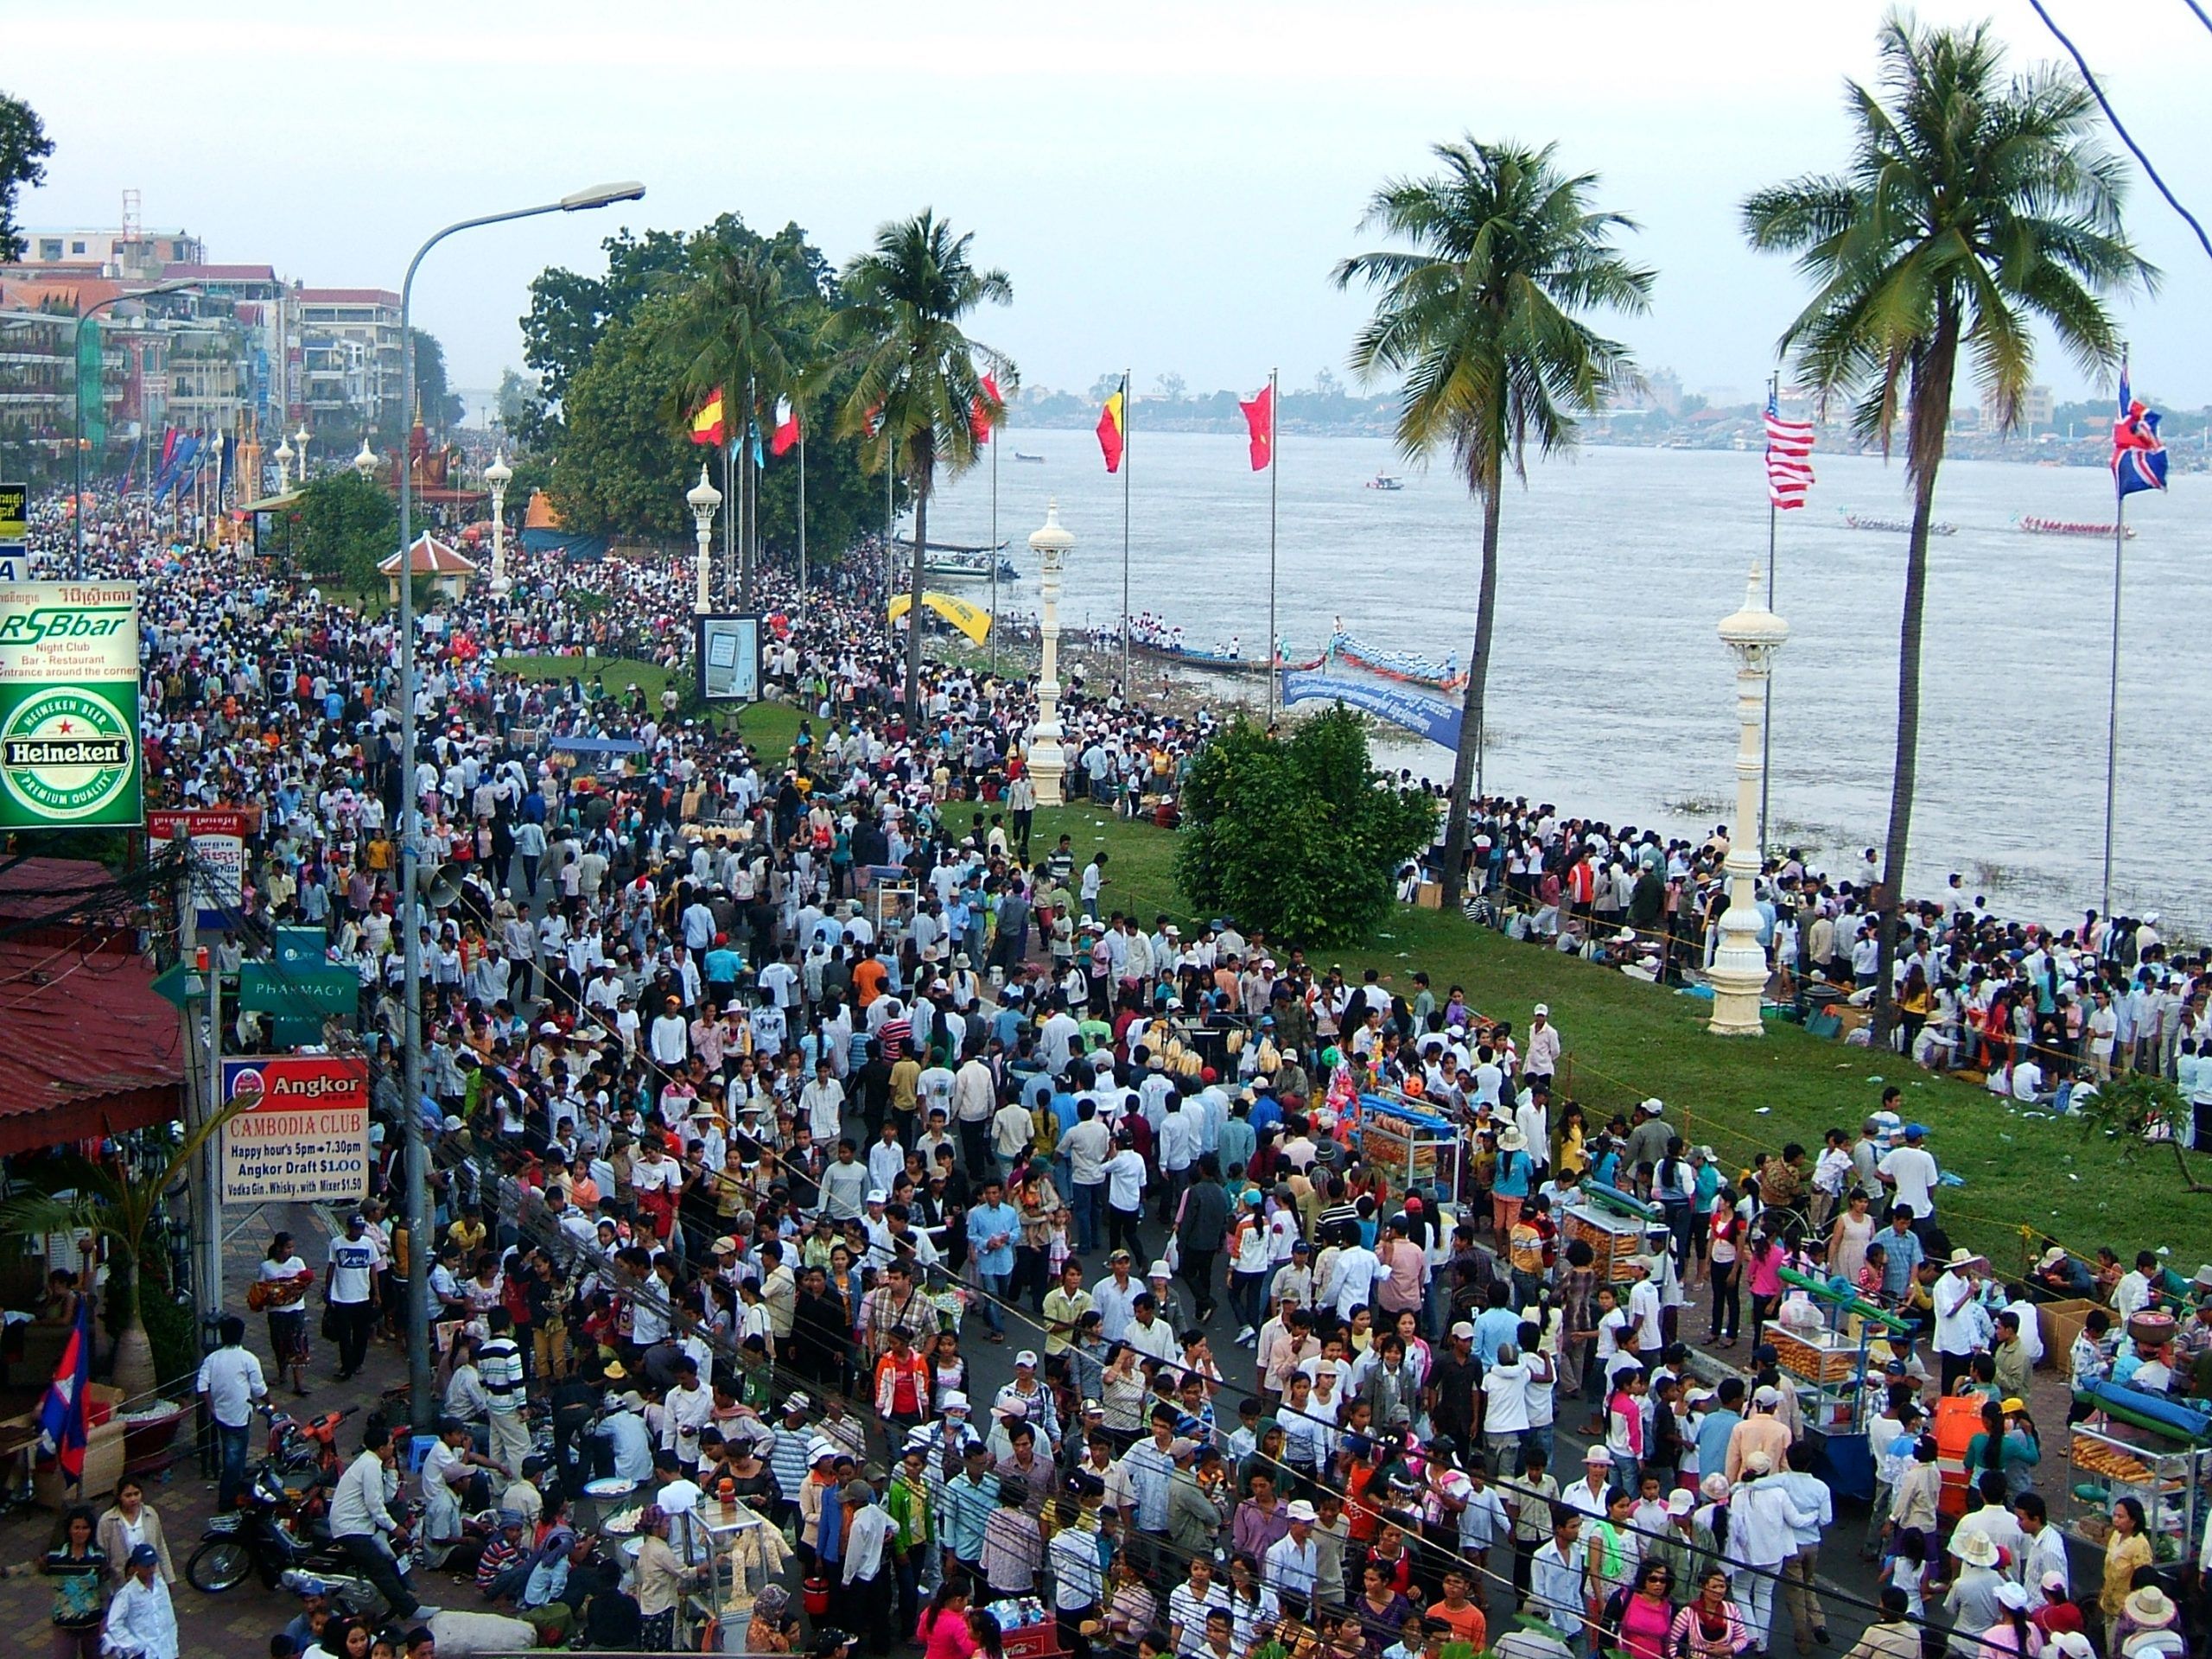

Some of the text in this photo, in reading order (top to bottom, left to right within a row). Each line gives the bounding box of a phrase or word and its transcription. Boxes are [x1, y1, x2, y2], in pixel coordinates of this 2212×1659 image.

[35, 642, 90, 654] Night Club
[22, 656, 39, 665] Bar
[49, 656, 105, 665] Restaurant
[46, 668, 82, 677] around
[85, 667, 101, 677] the
[104, 667, 137, 676] corner
[12, 742, 120, 763] Heineken
[21, 774, 111, 805] PREMIUM QUALITY
[256, 983, 345, 996] PHARMACY
[273, 1076, 359, 1098] Angkor
[230, 1114, 361, 1138] CAMBODIA CLUB
[231, 1145, 262, 1160] Happy
[264, 1143, 292, 1156] hour's
[296, 1142, 315, 1157] 5pm
[238, 1160, 361, 1179] Angkor Draft $1.00
[228, 1182, 250, 1197] Vodka
[320, 1179, 340, 1192] Mixer
[341, 1177, 362, 1192] $1.50
